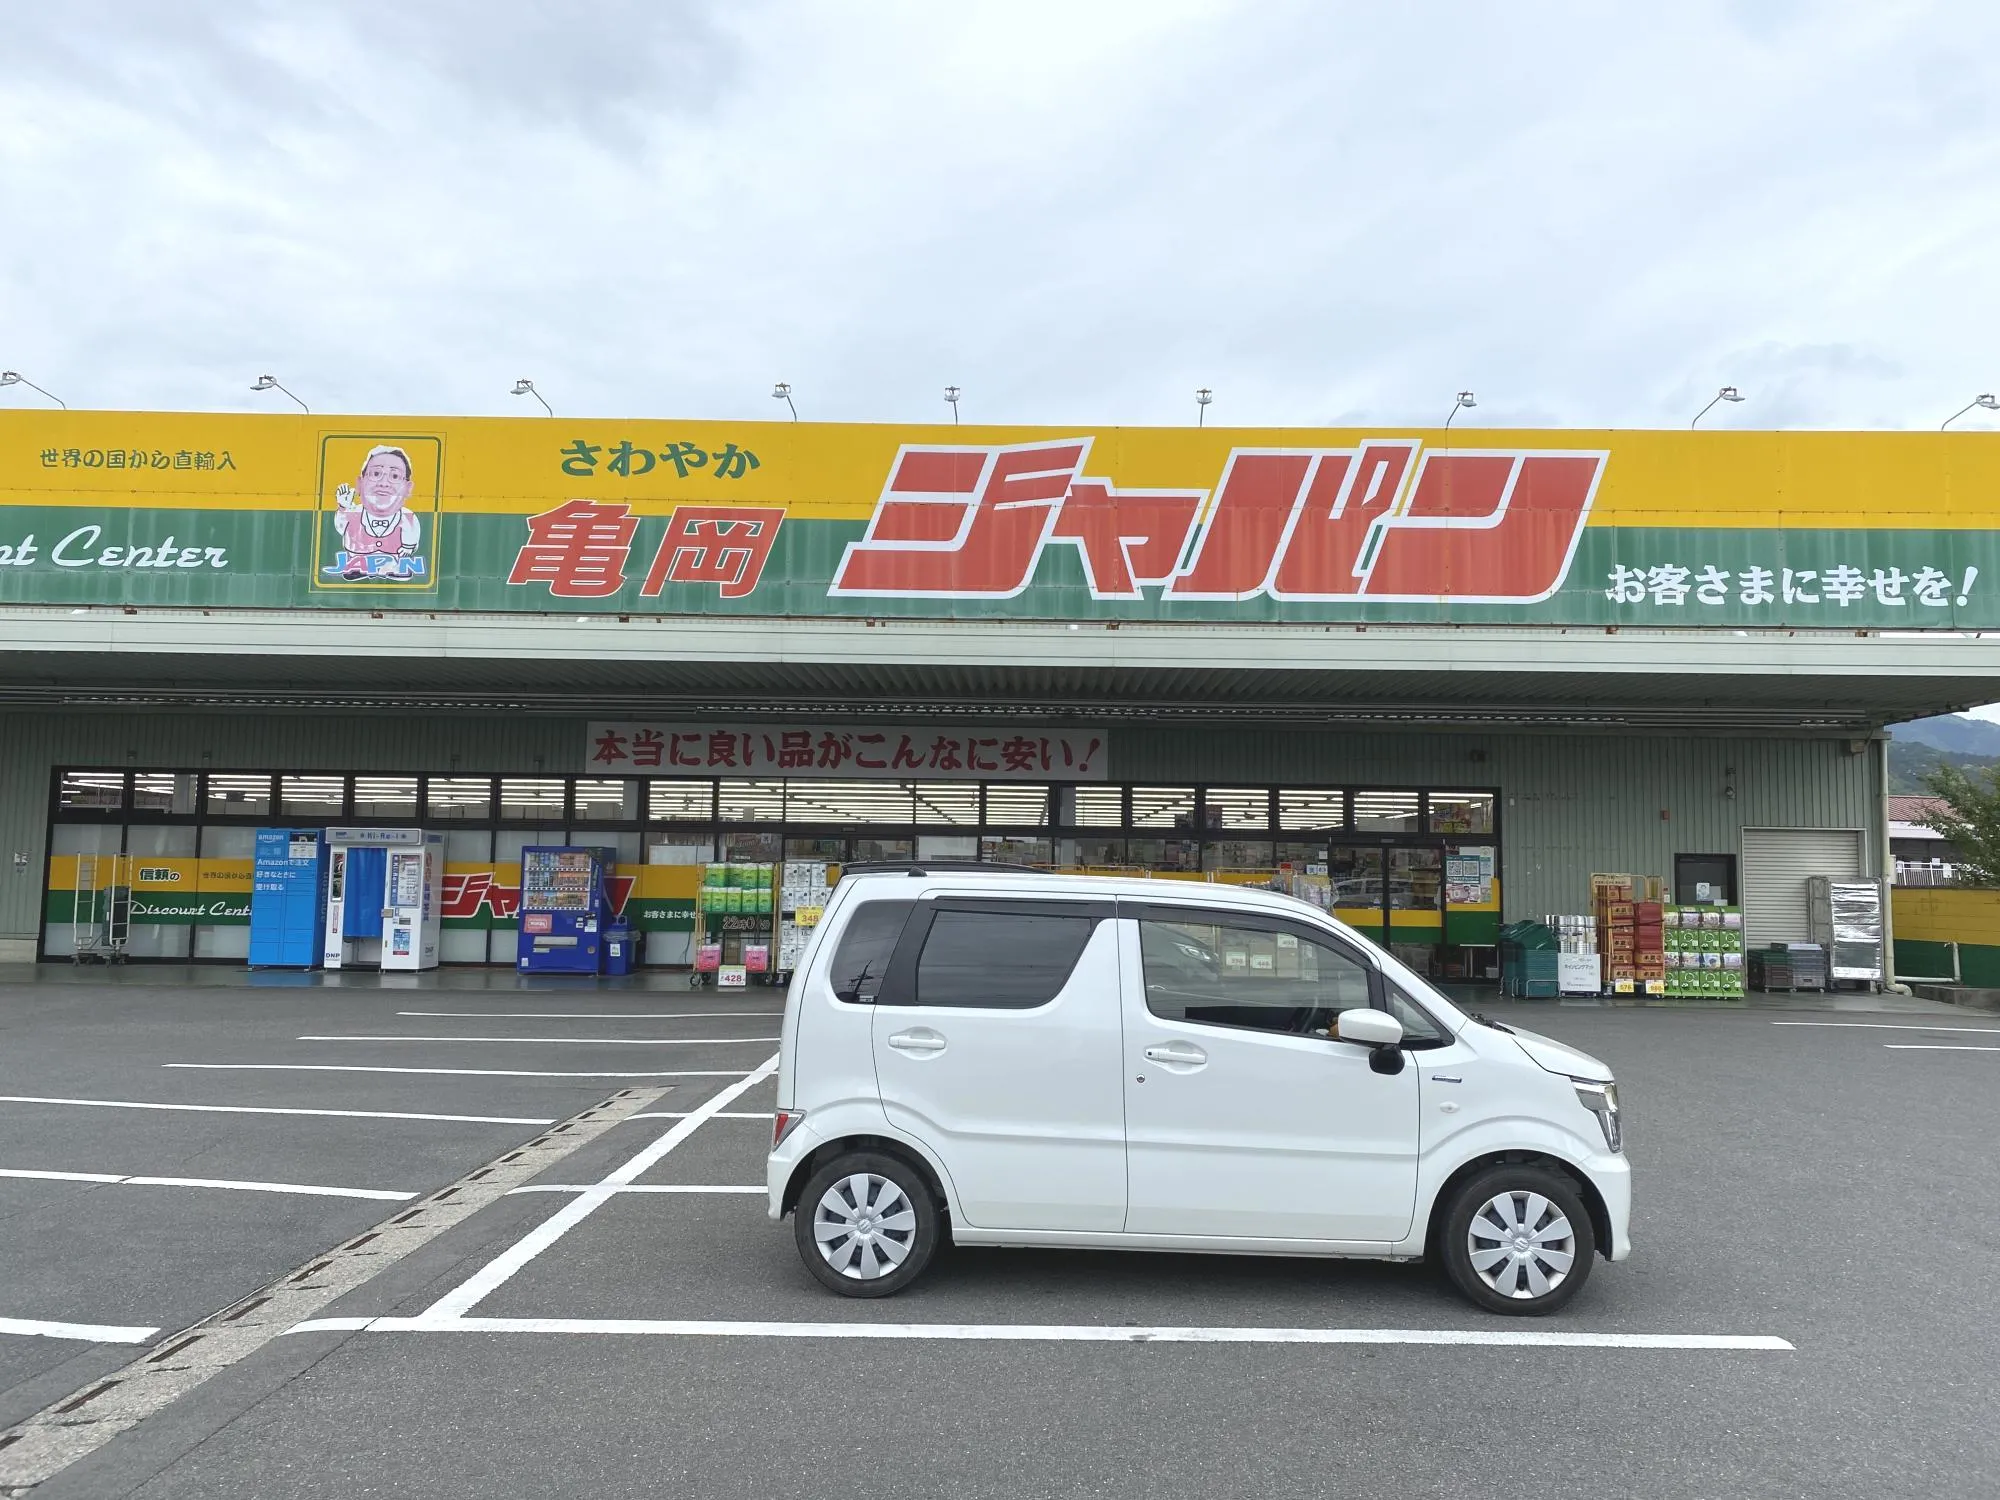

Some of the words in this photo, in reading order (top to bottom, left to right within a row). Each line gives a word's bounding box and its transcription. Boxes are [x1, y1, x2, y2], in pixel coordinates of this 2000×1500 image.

[40, 448, 237, 471] 世界の国から直輸入
[560, 439, 761, 479] さわやか
[506, 499, 787, 599] 亀岡
[827, 436, 1611, 605] ジャパン
[51, 524, 230, 568] Center
[1605, 563, 1979, 607] お客さまに幸せを!
[592, 728, 1102, 773] 本当に良い品がこんなに安い!
[140, 867, 181, 882] 信頼の
[724, 974, 743, 983] 428
